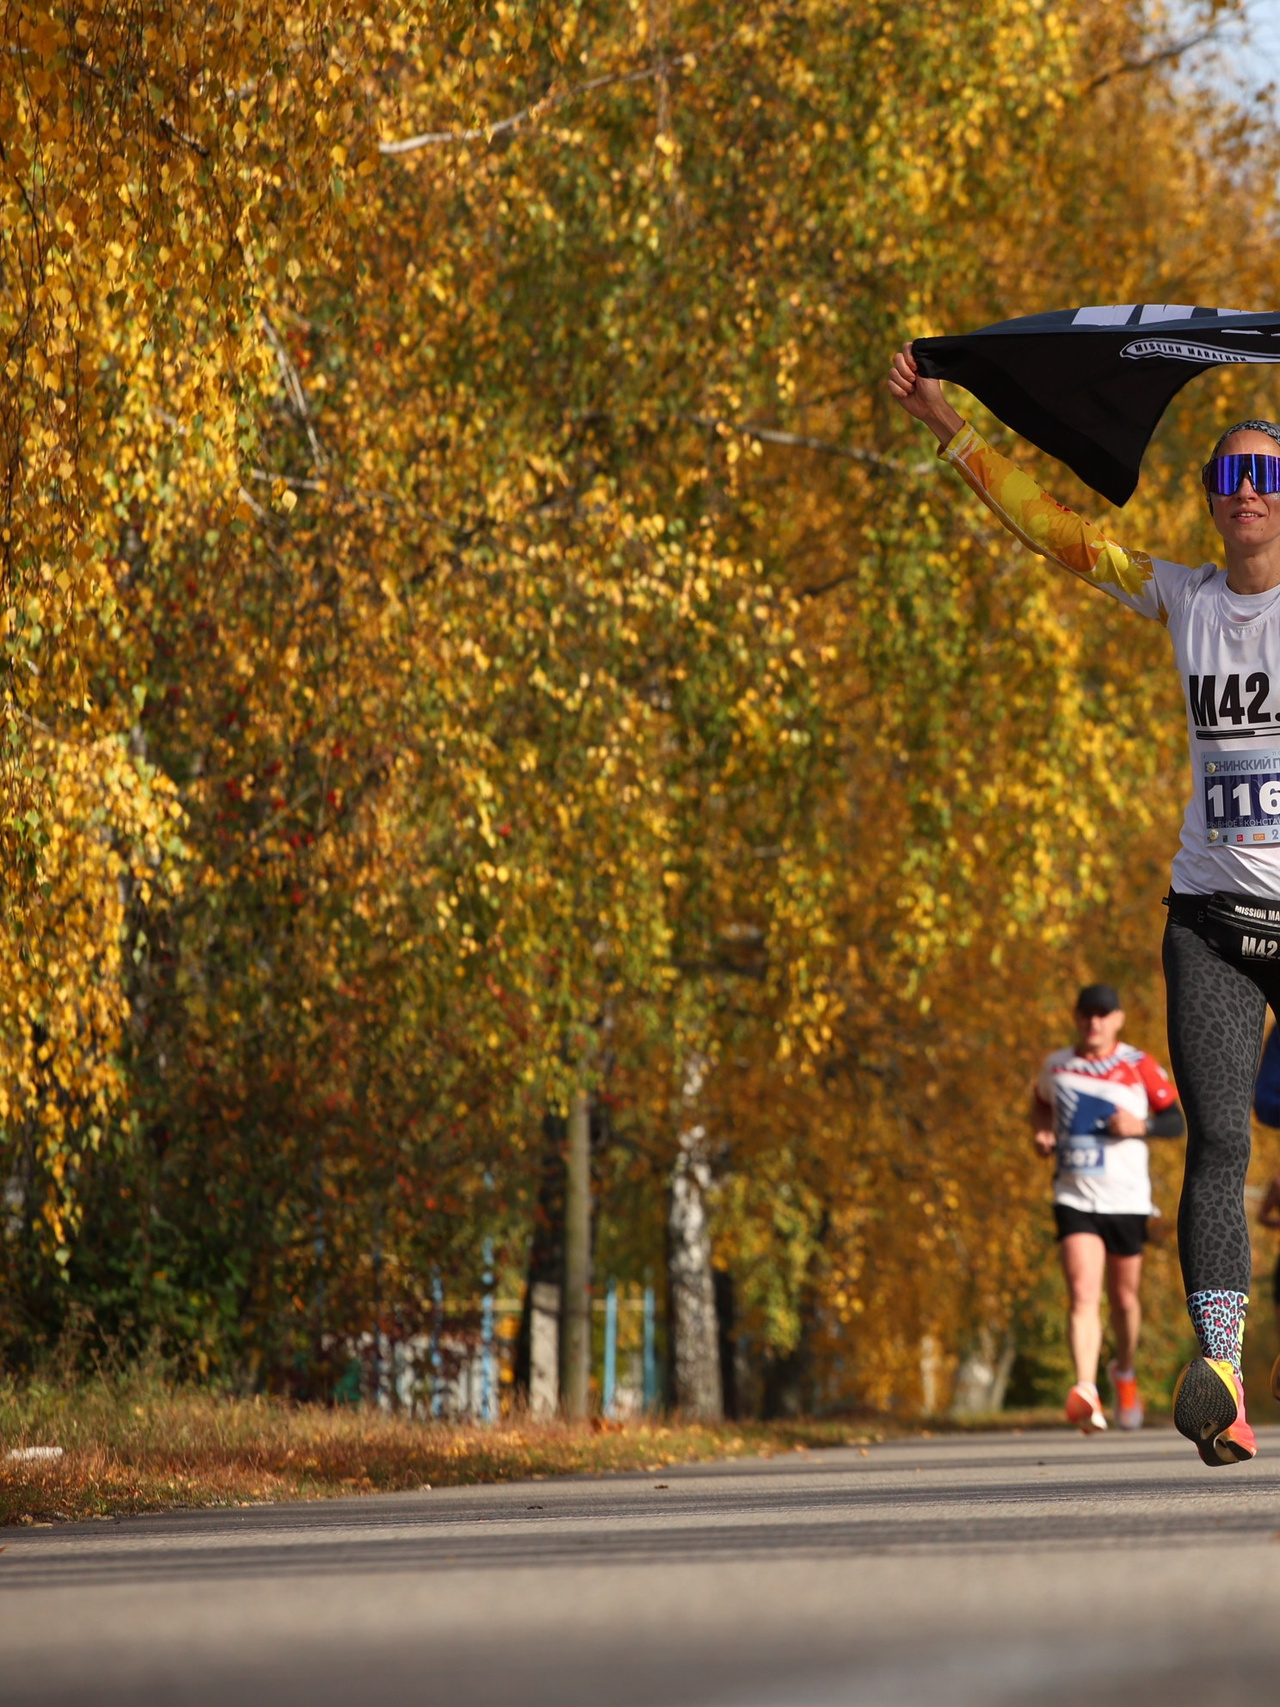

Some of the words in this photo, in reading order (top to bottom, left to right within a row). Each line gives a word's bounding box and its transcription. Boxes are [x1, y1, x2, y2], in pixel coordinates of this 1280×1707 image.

[1134, 342, 1182, 354] MISSION
[1204, 756, 1271, 773] ЕЕНИНСКИЙ
[1207, 819, 1238, 828] РЫБНОЕ
[1234, 904, 1267, 920] MISSION
